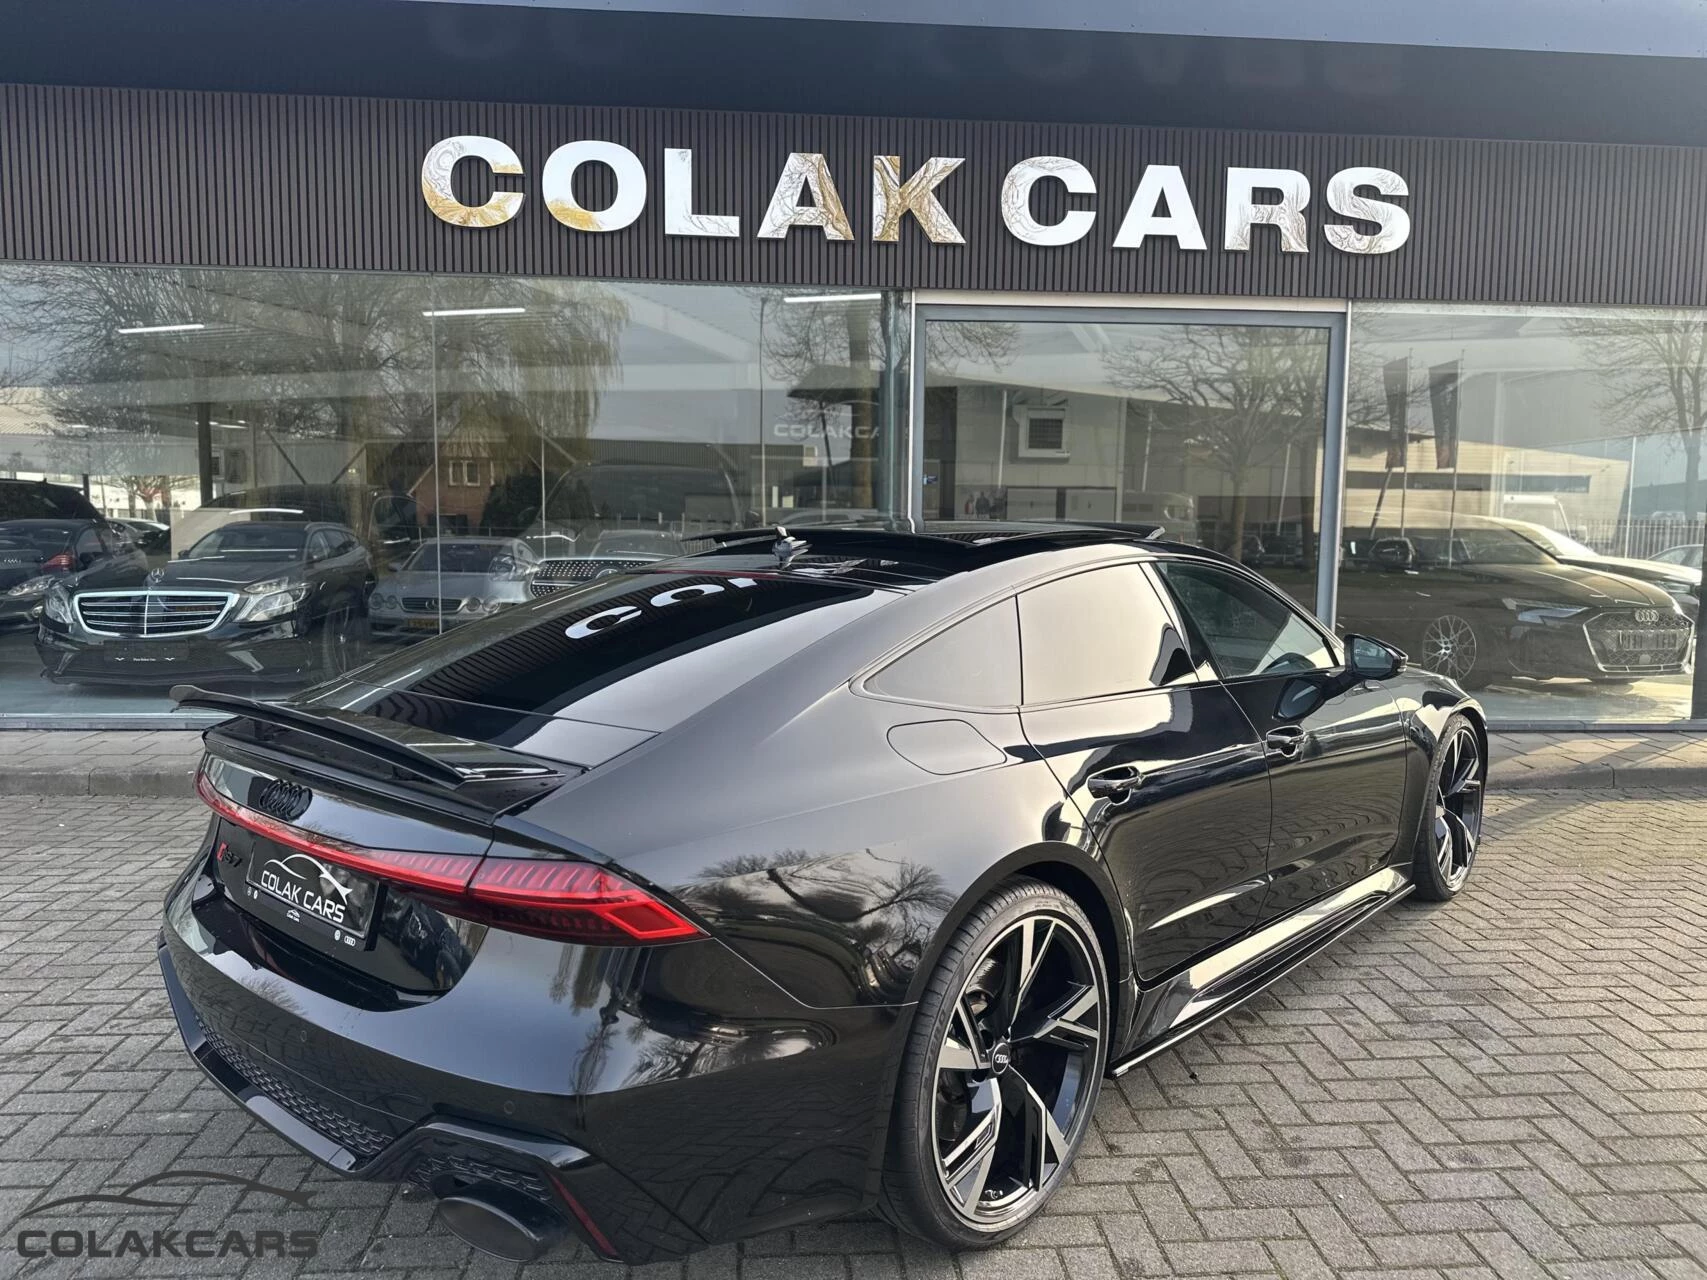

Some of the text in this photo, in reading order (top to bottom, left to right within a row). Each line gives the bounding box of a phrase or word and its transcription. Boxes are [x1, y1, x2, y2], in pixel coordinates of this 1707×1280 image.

[420, 134, 1411, 255] COLAK CARS
[260, 870, 346, 923] COLAK CARS
